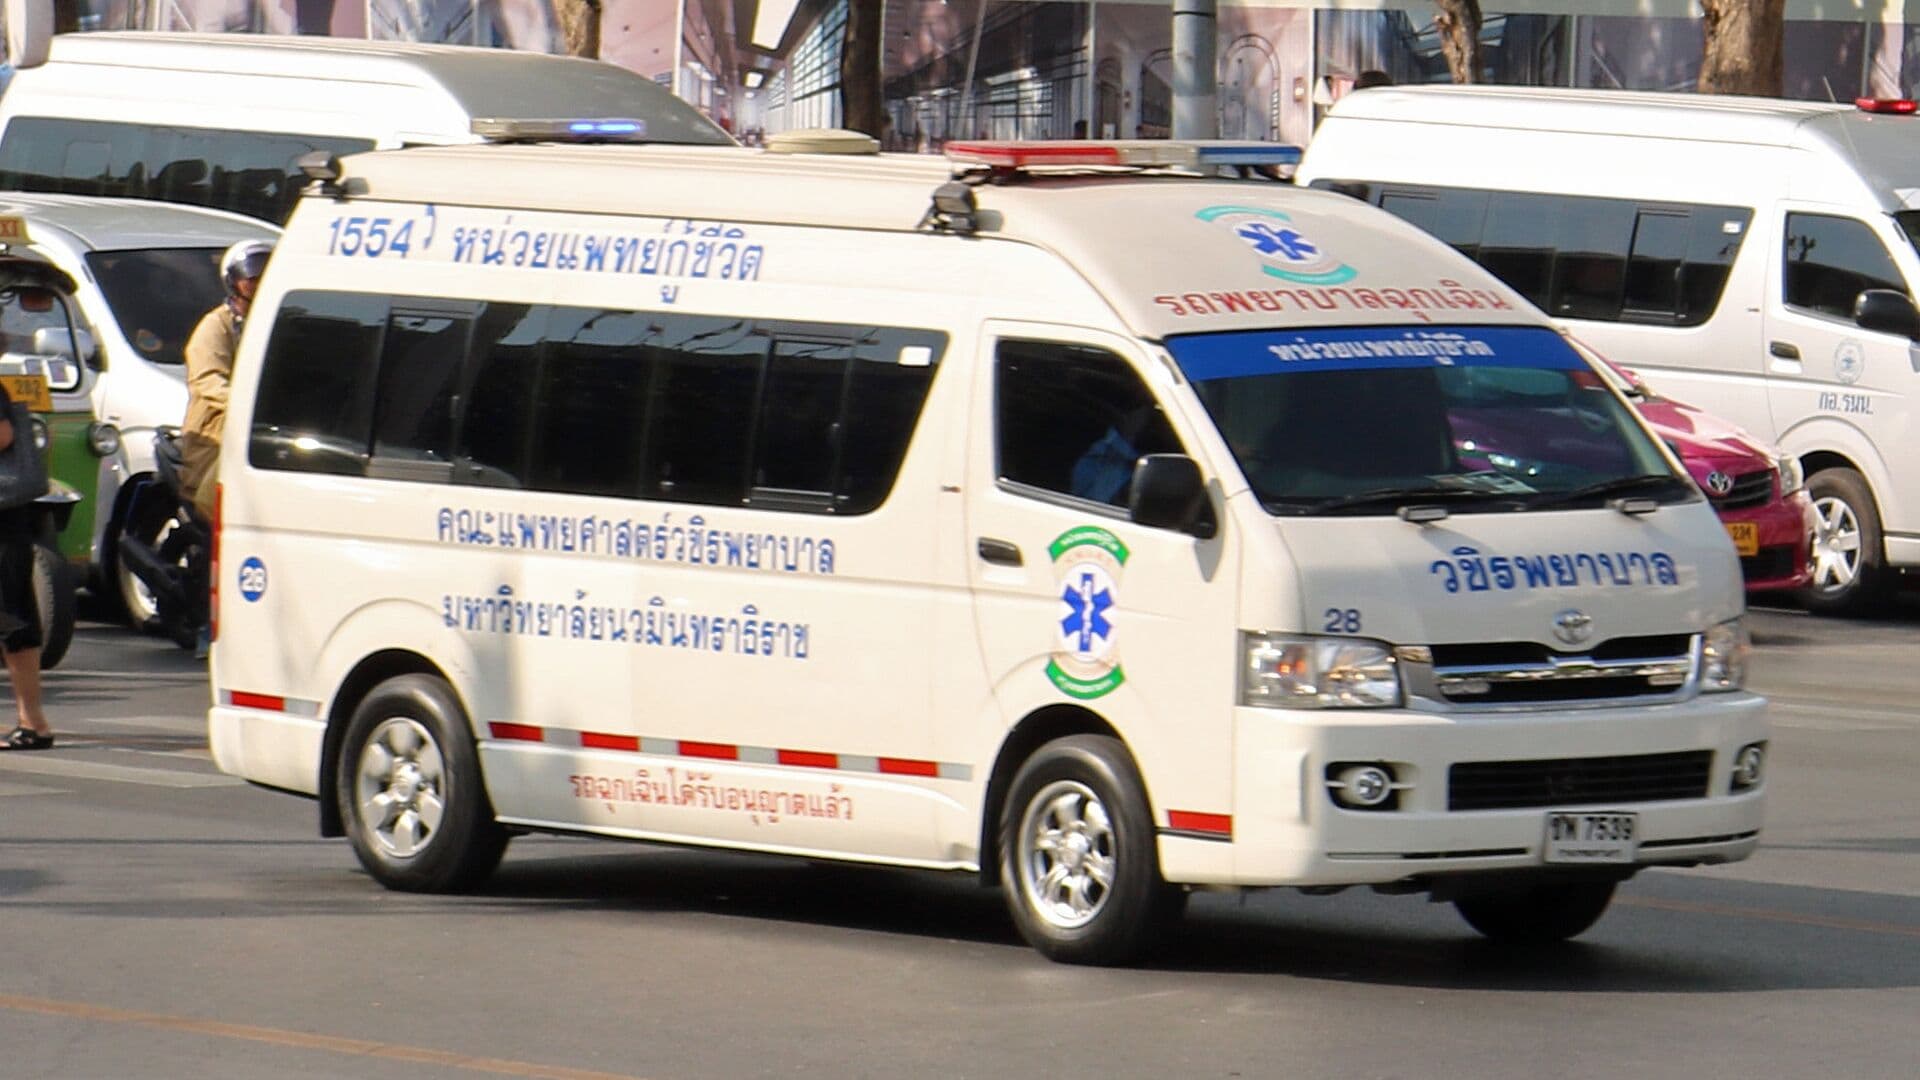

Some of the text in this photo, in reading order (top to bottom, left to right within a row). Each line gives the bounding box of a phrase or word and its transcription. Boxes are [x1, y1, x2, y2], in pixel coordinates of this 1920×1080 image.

[328, 214, 765, 304] 1554 หน่วยแพทย์กู้ชีวิต
[1154, 279, 1513, 322] รถพยาบาลฉุกเฉิน
[1268, 332, 1495, 366] หน่วยแพทย์กู้ชีวิต
[437, 506, 836, 574] คณะแพทยศาสตร์วชิรพยาบาล
[241, 566, 266, 593] 28
[1429, 545, 1679, 594] วชิรพยาบาล
[441, 583, 810, 660] มหาวิทยาลัยนวมินทราธิราช
[1324, 608, 1362, 634] 28
[568, 768, 854, 825] รถฉุกเฉินได้รับอนุญาตแล้ว
[1584, 815, 1634, 841] 7539
